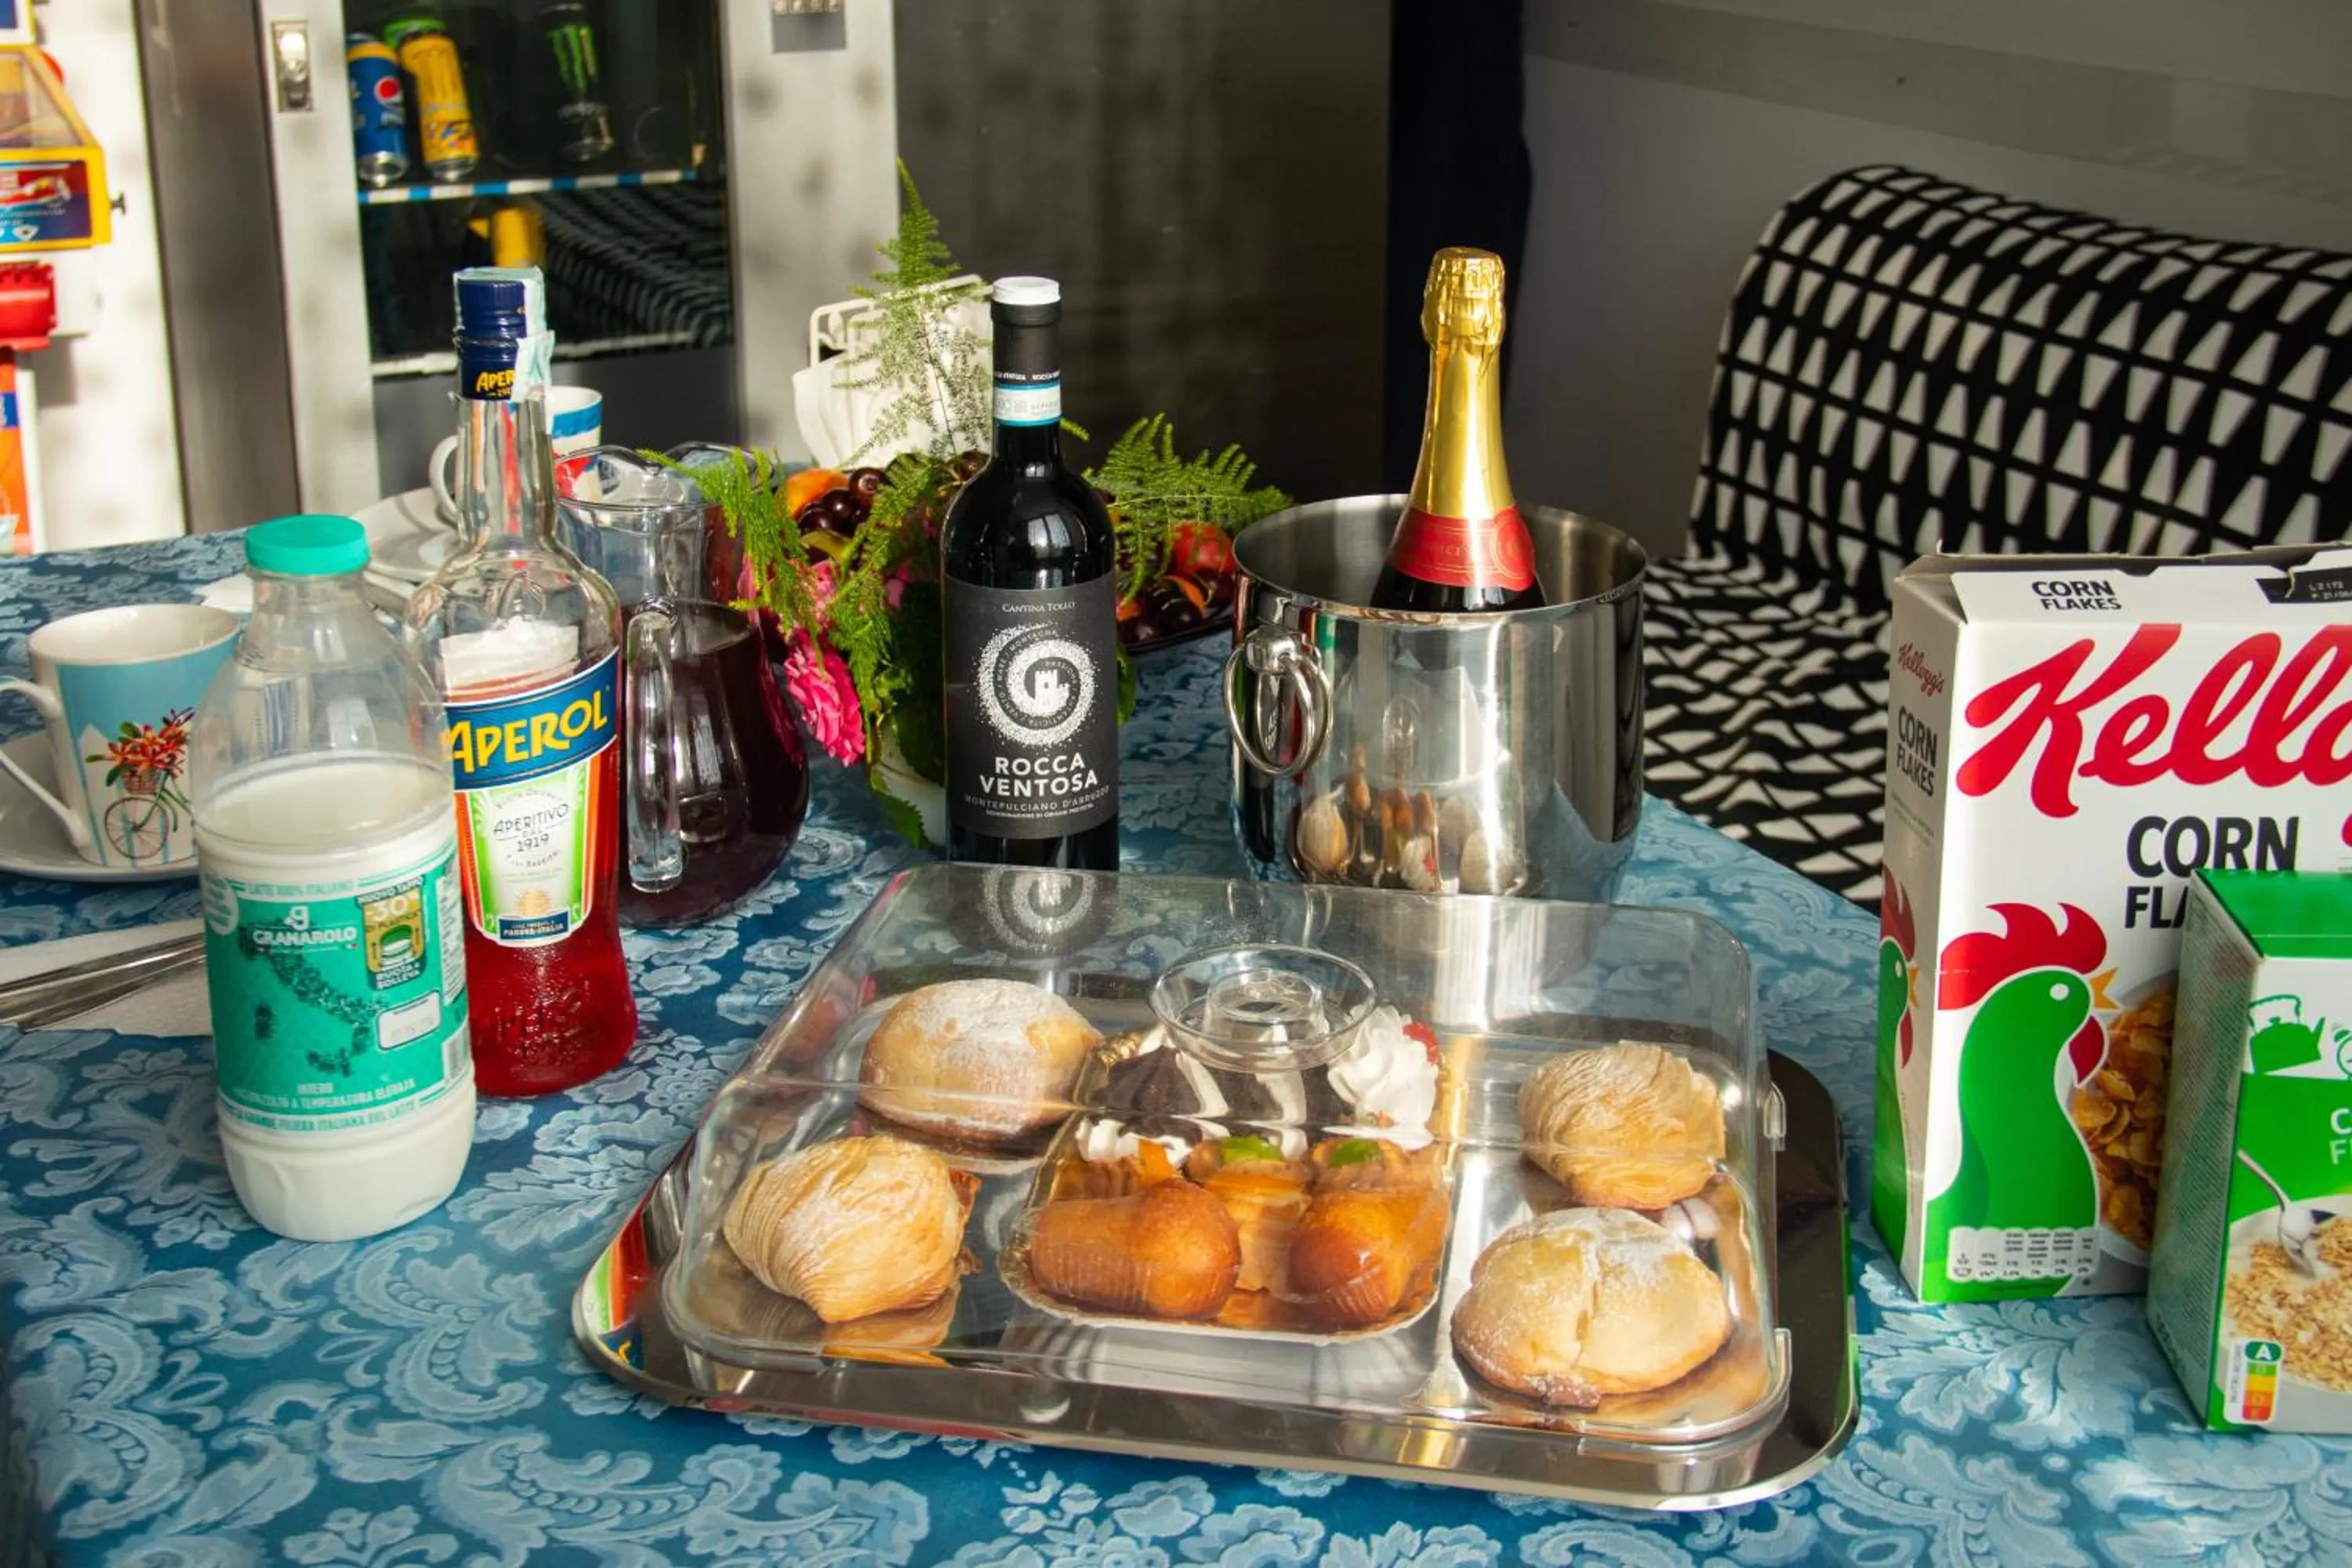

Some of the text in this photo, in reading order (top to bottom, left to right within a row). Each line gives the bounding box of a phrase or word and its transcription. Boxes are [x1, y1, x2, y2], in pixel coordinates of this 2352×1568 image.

[475, 369, 515, 393] APER
[2031, 579, 2115, 597] CORN
[1002, 603, 1045, 612] CANTINA
[2040, 597, 2122, 610] FLAKES
[442, 690, 608, 773] APEROL
[1898, 706, 1937, 768] CORN
[995, 752, 1086, 776] ROCCA
[1896, 742, 1934, 797] FLAKES
[979, 769, 1098, 797] VENTOSA
[964, 793, 1058, 811] MONTEPULCIANO
[493, 803, 568, 836] APERITIVO
[517, 833, 550, 852] 1919
[2126, 815, 2300, 879] CORN
[252, 927, 358, 946] GRANAROLO
[2255, 1343, 2272, 1360] A
